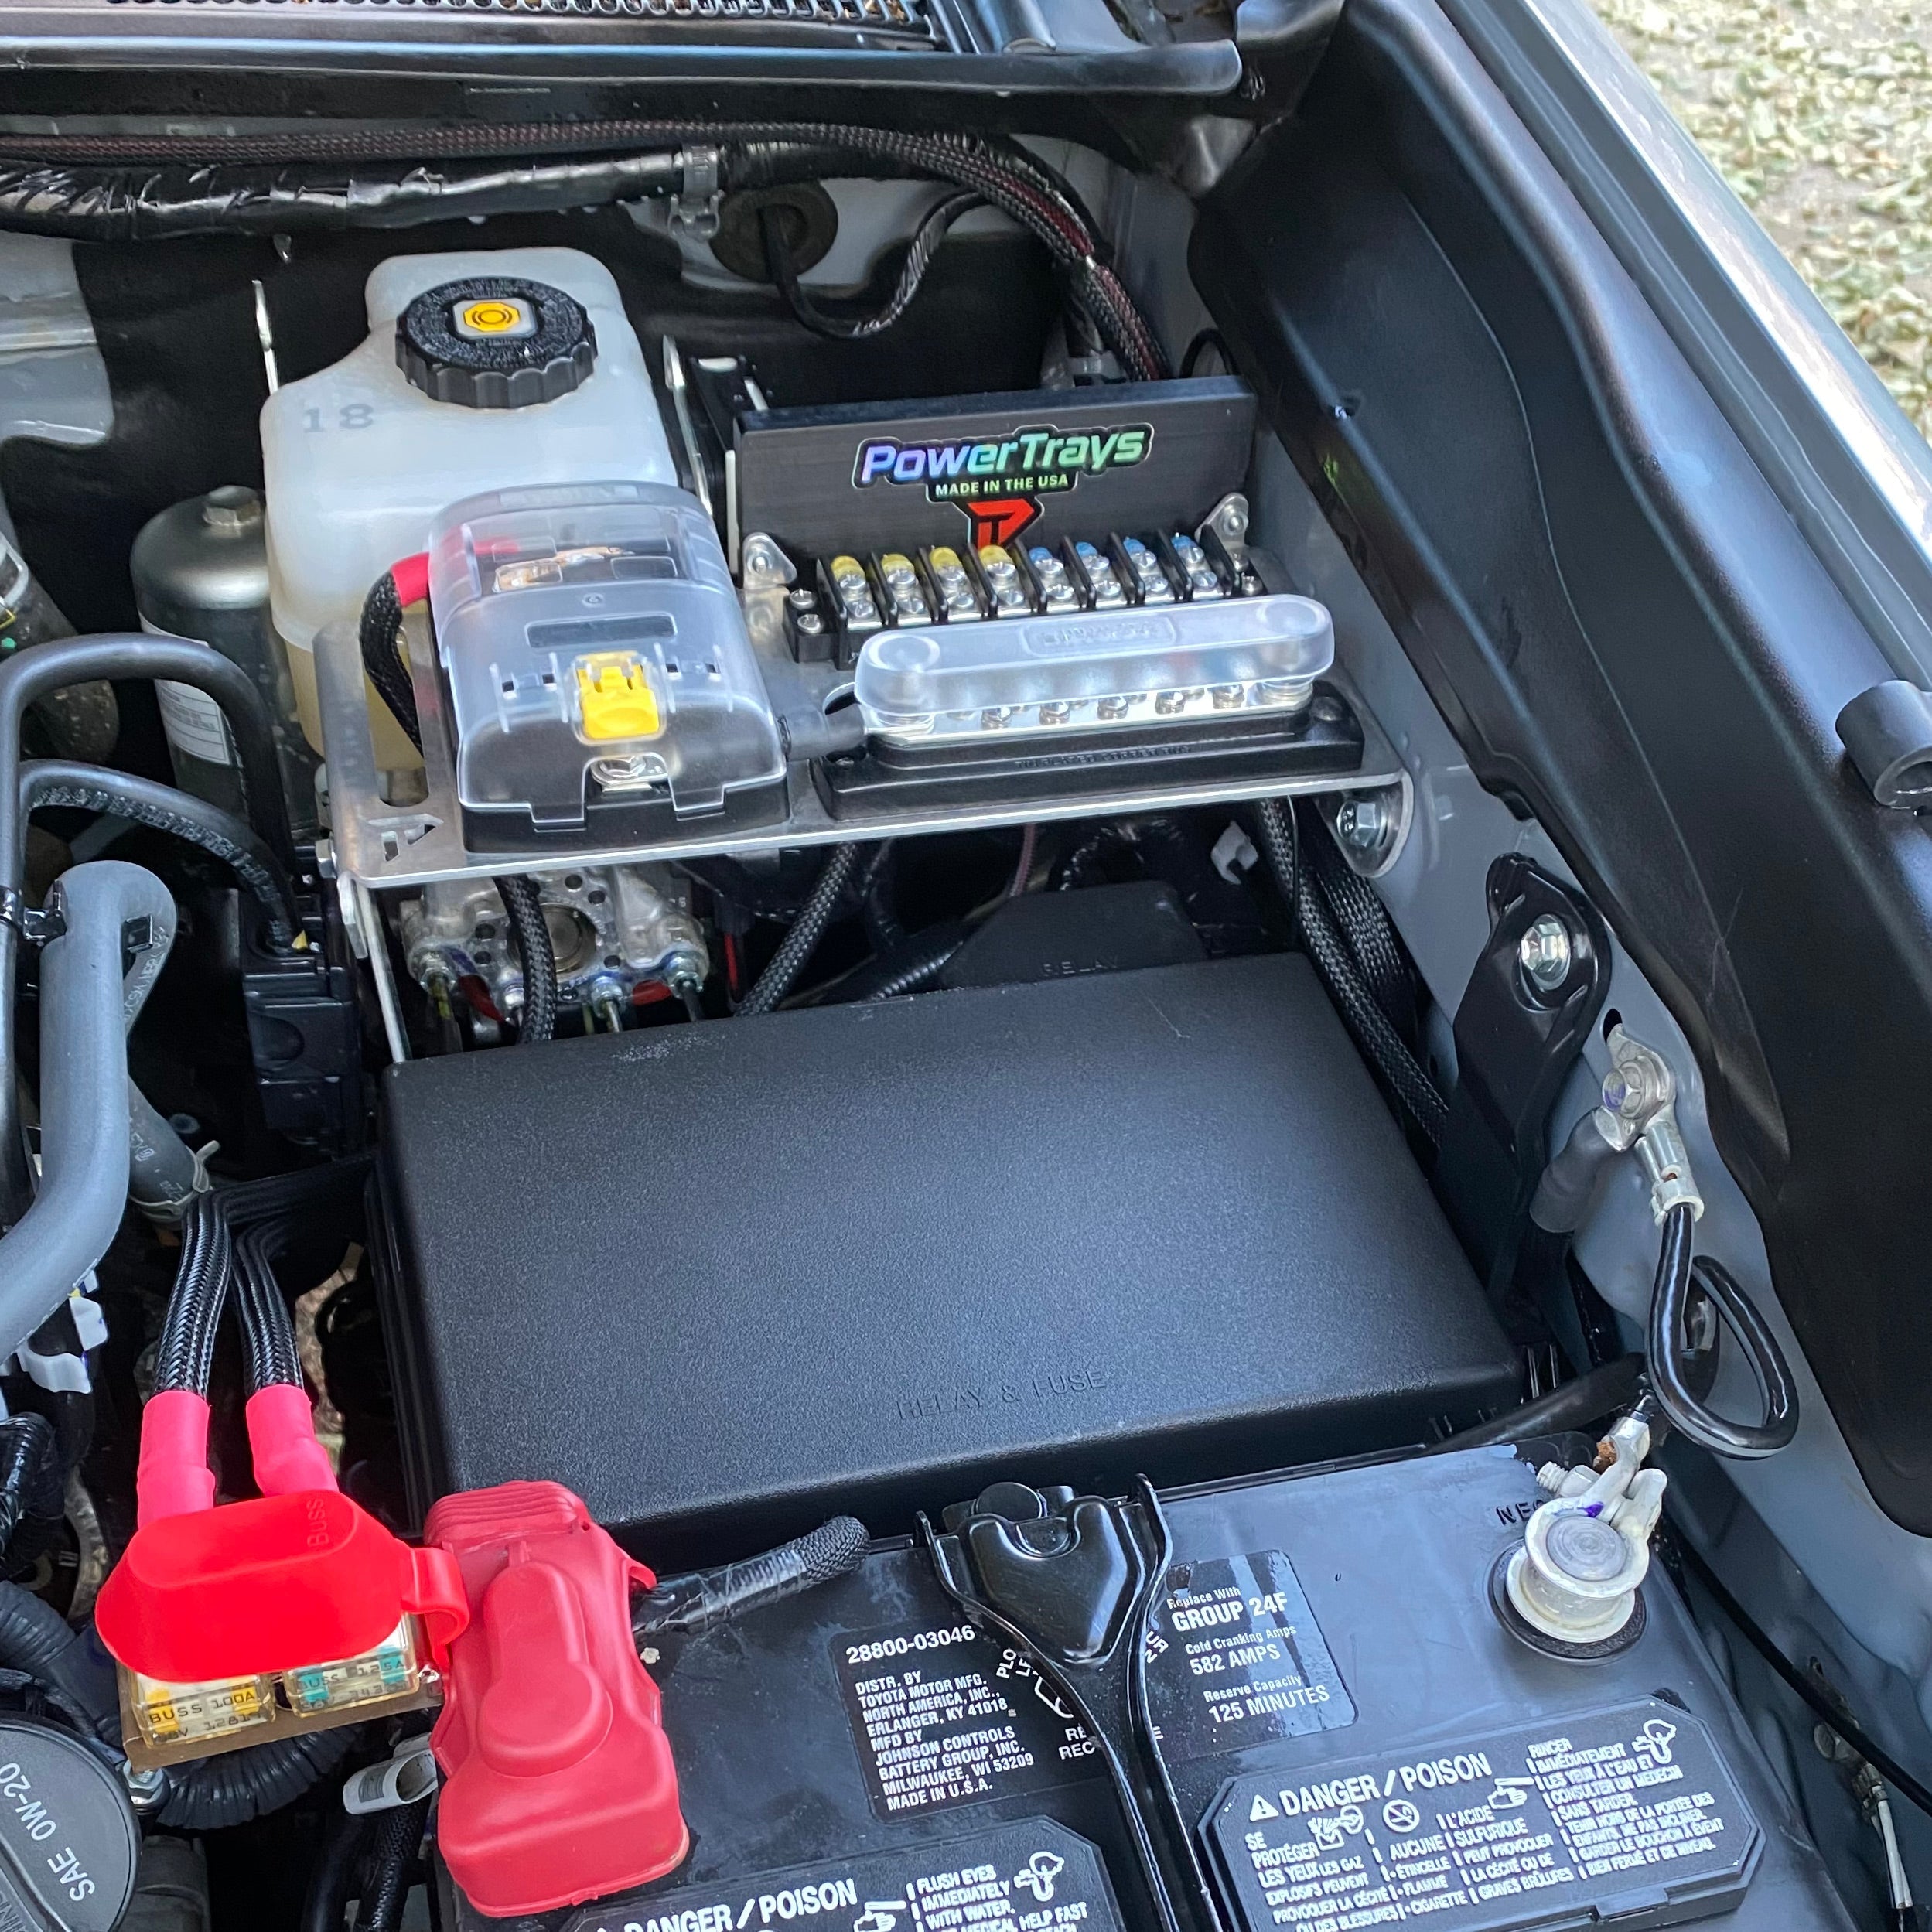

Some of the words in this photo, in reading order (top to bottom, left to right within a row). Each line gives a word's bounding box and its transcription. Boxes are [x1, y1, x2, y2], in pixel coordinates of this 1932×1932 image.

[862, 431, 1146, 484] PowerTrays
[935, 483, 979, 497] MADE
[983, 480, 1001, 493] IN
[1005, 478, 1034, 492] THE
[1038, 475, 1068, 488] USA
[897, 1387, 983, 1419] RELAY
[1001, 1384, 1021, 1403] &
[1033, 1370, 1107, 1398] FUSE
[1166, 1592, 1213, 1609] Replace
[1214, 1586, 1241, 1600] With
[1172, 1602, 1244, 1632] GROUP
[1249, 1592, 1288, 1617] 24F
[846, 1625, 975, 1664] 28800-03046
[1185, 1641, 1212, 1655] Cold
[1214, 1631, 1263, 1650] Cranking
[1267, 1624, 1297, 1639] Amps
[996, 1649, 1017, 1678] PLO
[1190, 1656, 1225, 1675] 582
[1229, 1644, 1281, 1668] AMPS
[855, 1676, 902, 1695] DISTR.
[905, 1671, 922, 1685] BY
[858, 1689, 906, 1709] TOYOTA
[910, 1680, 952, 1698] MOTOR
[954, 1673, 987, 1688] MFG.
[1203, 1685, 1251, 1703] Reserve
[1254, 1674, 1302, 1695] Capacity
[149, 1703, 202, 1724] BUSS
[863, 1703, 905, 1723] NORTH
[908, 1693, 968, 1714] AMERICA,
[867, 1716, 944, 1737] ERLANGER,
[947, 1707, 965, 1721] KY
[968, 1698, 1007, 1715] 41018
[1208, 1703, 1244, 1724] 125
[1247, 1685, 1330, 1715] MINUTES
[871, 1734, 903, 1751] MFD
[906, 1730, 923, 1744] BY
[876, 1741, 940, 1766] JOHNSON
[944, 1725, 1015, 1752] CONTROLS
[879, 1757, 938, 1780] BATTERY
[943, 1749, 994, 1768] GROUP,
[996, 1741, 1025, 1759] INC.
[883, 1770, 970, 1795] MILWAUKEE,
[971, 1763, 991, 1777] WI
[993, 1753, 1034, 1773] 53209
[1543, 1771, 1568, 1790] LES
[1637, 1754, 1654, 1770] ET
[886, 1793, 927, 1811] MADE
[931, 1786, 946, 1801] IN
[949, 1780, 993, 1797] U.S.A.
[1279, 1774, 1381, 1817] DANGER
[1400, 1752, 1493, 1793] POISON
[1549, 1781, 1617, 1805] CONSULTER
[1615, 1777, 1635, 1791] UN
[1446, 1805, 1496, 1830] L'ACIDE
[1557, 1802, 1591, 1821] SANS
[1624, 1807, 1642, 1821] DE
[1640, 1804, 1656, 1818] LA
[1244, 1832, 1267, 1851] SE
[1454, 1818, 1529, 1848] SULFURIQUE
[1251, 1842, 1320, 1869] PROTÉGER
[1389, 1835, 1447, 1862] AUCUNE
[1463, 1845, 1491, 1865] PEUT
[47, 1847, 95, 1901] SAE
[916, 1872, 961, 1895] FLUSH
[960, 1864, 997, 1886] EYES
[1258, 1869, 1285, 1888] LES
[1284, 1862, 1321, 1883] YEUX
[1319, 1860, 1341, 1876] LES
[1340, 1855, 1365, 1872] GAZ
[1470, 1867, 1487, 1883] LA
[1521, 1856, 1538, 1872] OU
[1539, 1852, 1555, 1869] DE
[921, 1880, 1010, 1913] IMMEDIATELY
[1322, 1872, 1370, 1894] PEUVENT
[1402, 1875, 1449, 1897] FLAMME
[1477, 1878, 1522, 1901] GRAVES
[758, 1878, 858, 1924] POISON
[925, 1908, 963, 1930] WITH
[962, 1899, 1016, 1922] WATER.
[1019, 1910, 1053, 1931] HELP
[1054, 1901, 1088, 1922] FAST
[1337, 1896, 1354, 1911] LA
[1410, 1890, 1469, 1915] CIGARETTE
